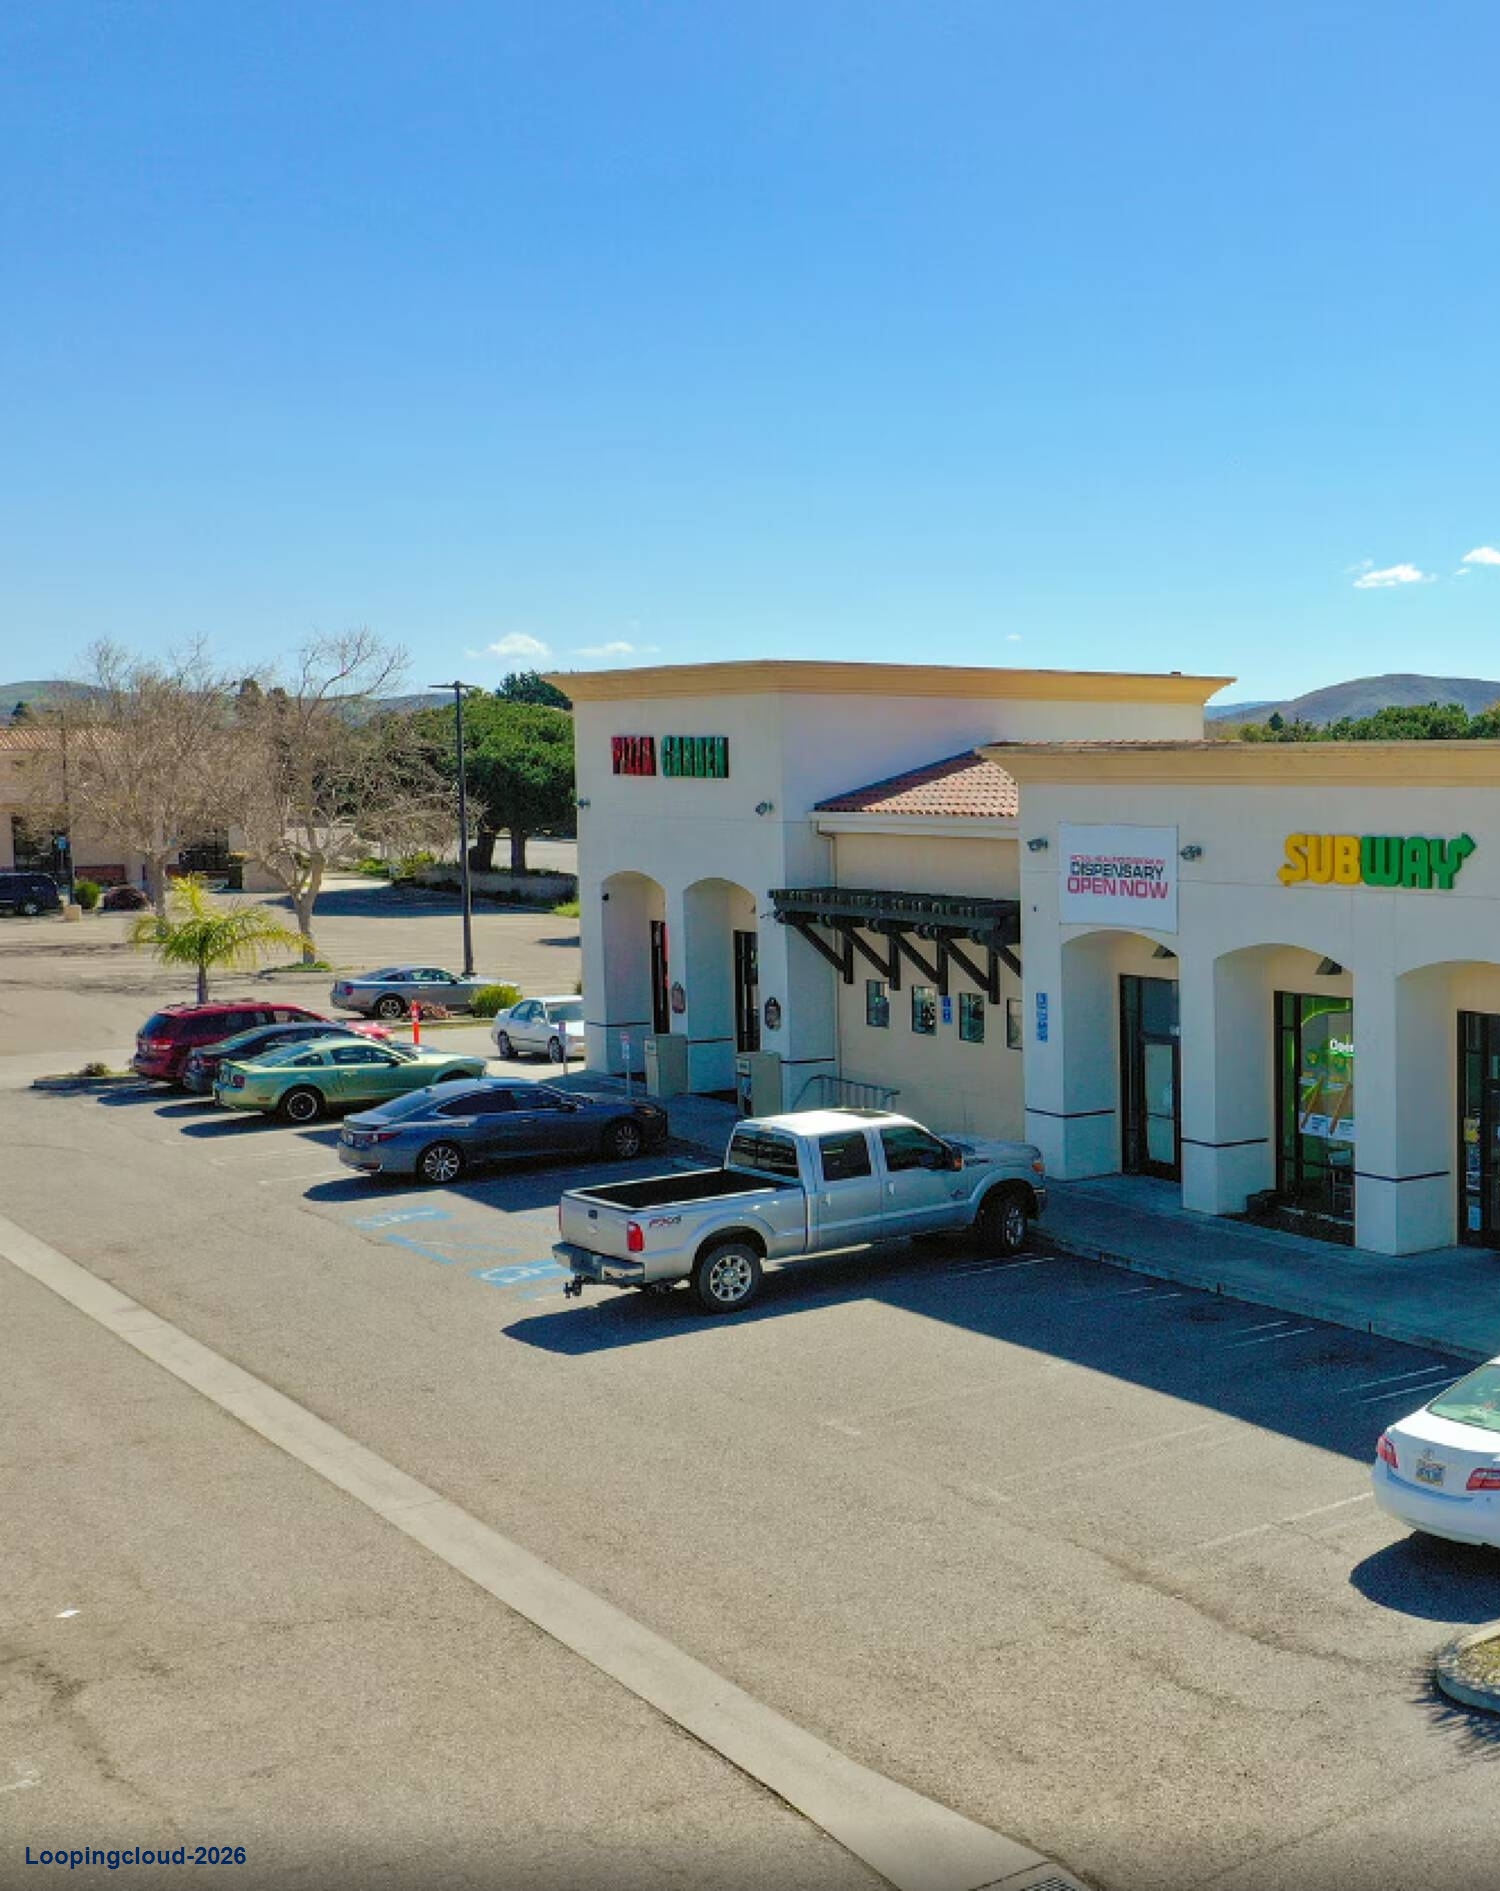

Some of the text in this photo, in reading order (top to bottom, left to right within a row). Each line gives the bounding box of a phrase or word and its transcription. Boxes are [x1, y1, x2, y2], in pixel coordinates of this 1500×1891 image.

[1070, 861, 1164, 880] DISPENSARY
[1276, 832, 1476, 890] SUBWAY
[1067, 877, 1168, 899] OPEN NOW
